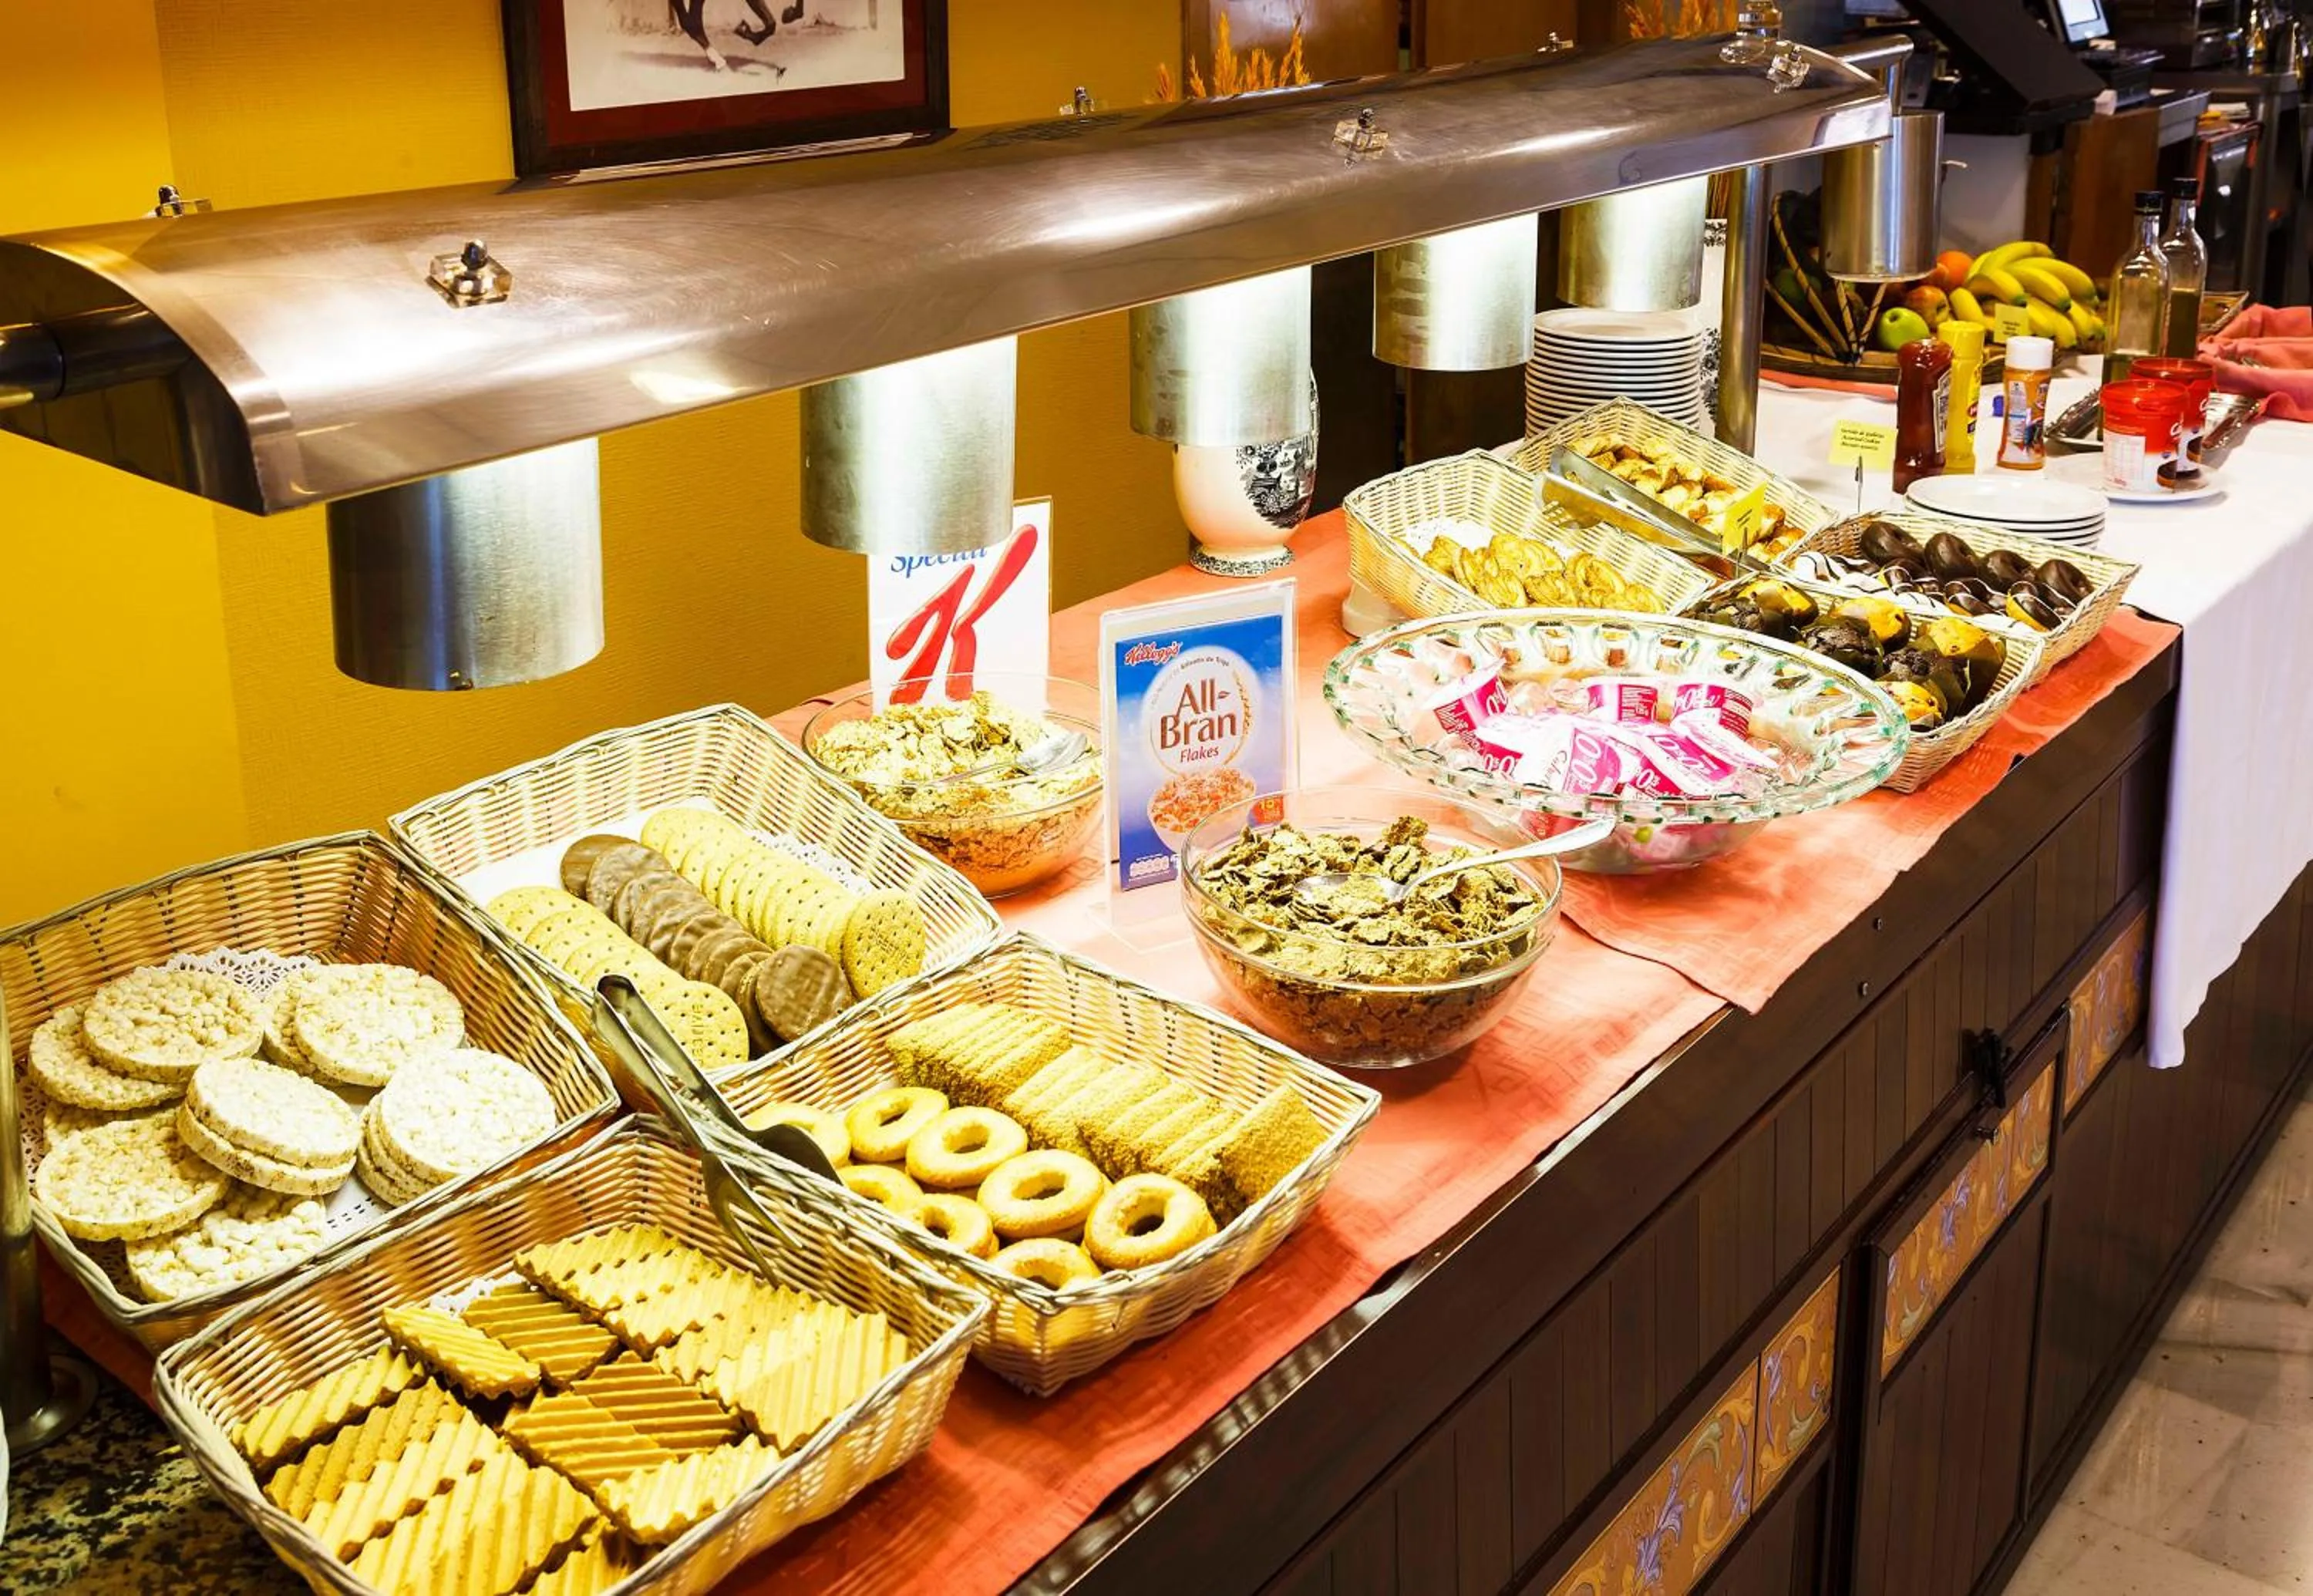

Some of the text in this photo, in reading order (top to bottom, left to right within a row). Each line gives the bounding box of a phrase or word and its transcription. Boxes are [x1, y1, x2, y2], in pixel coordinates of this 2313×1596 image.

[887, 524, 1038, 705] K
[1176, 678, 1231, 715] All-
[1160, 712, 1237, 749] Bran
[1180, 746, 1219, 763] Flakes
